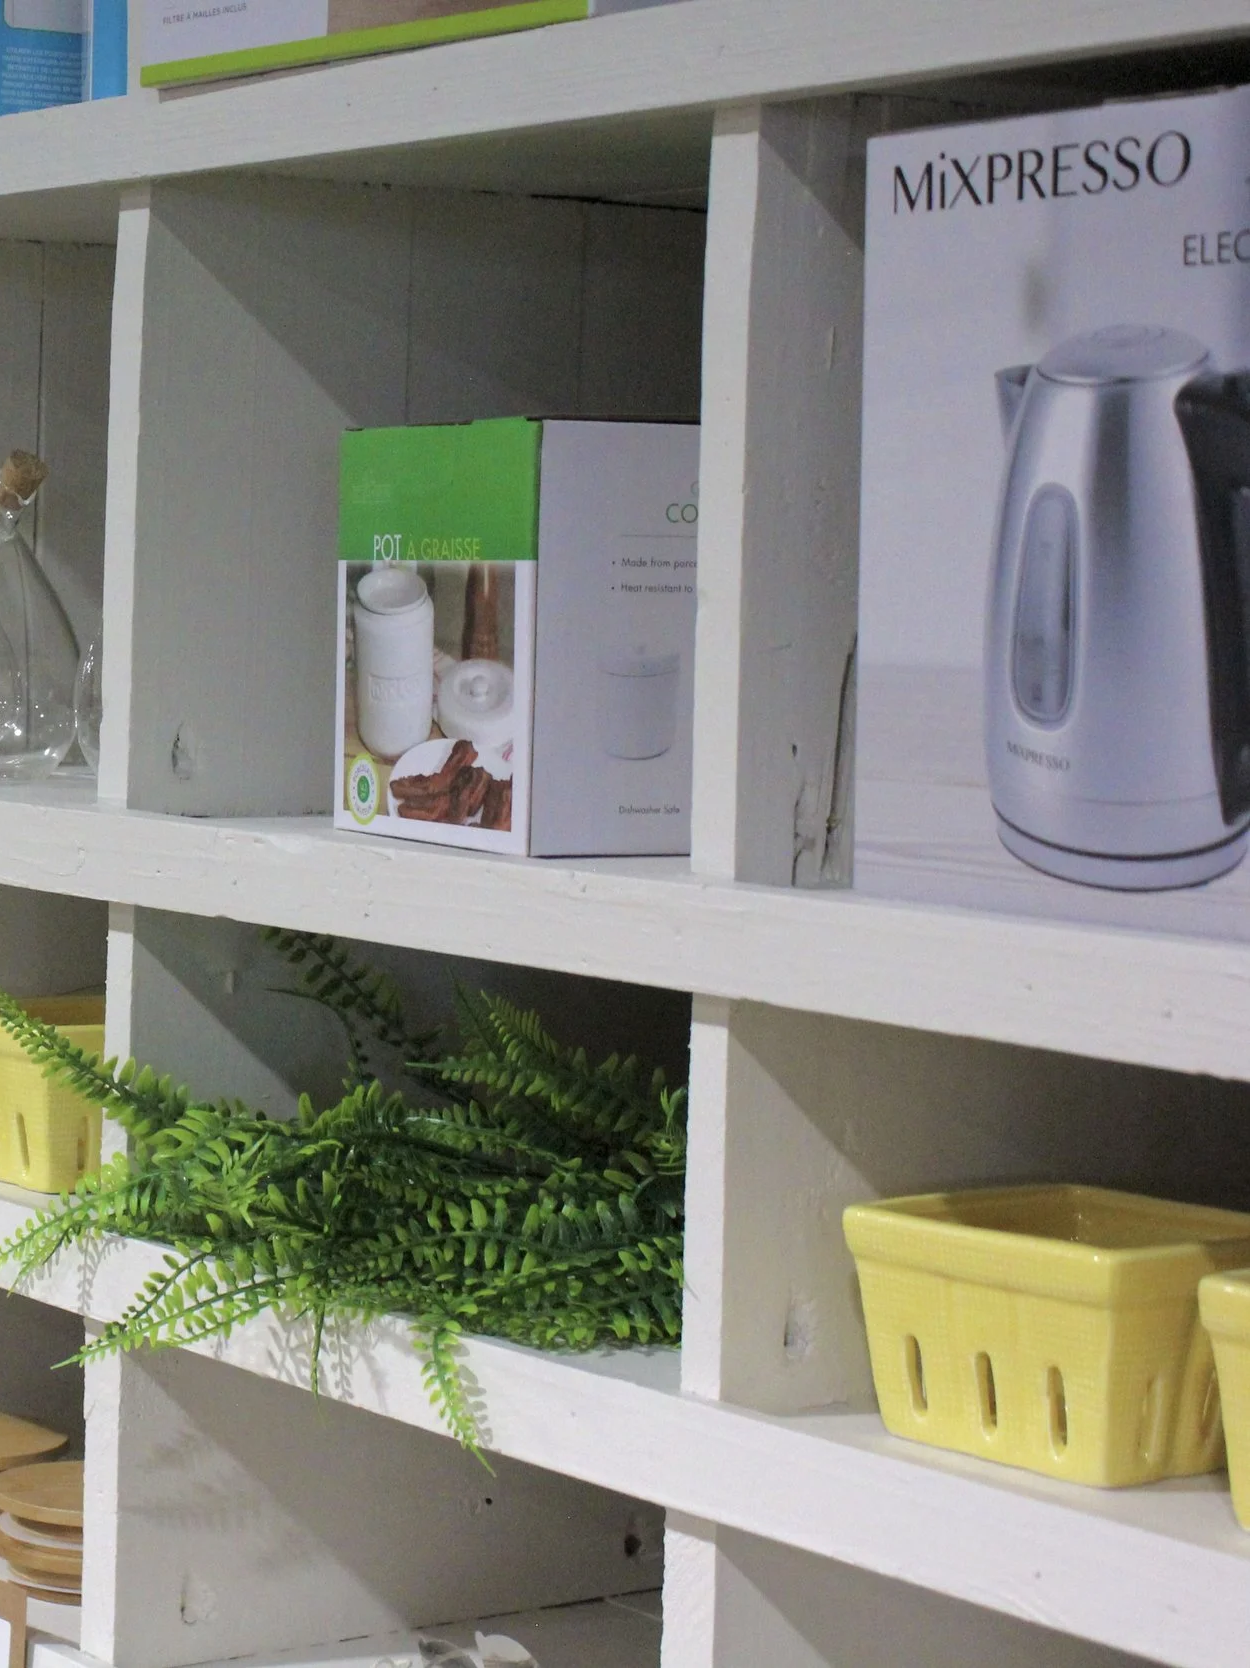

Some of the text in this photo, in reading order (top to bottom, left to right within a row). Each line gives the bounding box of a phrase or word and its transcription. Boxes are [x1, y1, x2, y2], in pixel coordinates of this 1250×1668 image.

[373, 534, 402, 560] POT
[420, 537, 482, 560] GRAISSE
[620, 557, 648, 568] Made
[650, 557, 670, 568] from
[620, 583, 693, 593] Heat resistant to
[618, 804, 661, 815] Dishwasher
